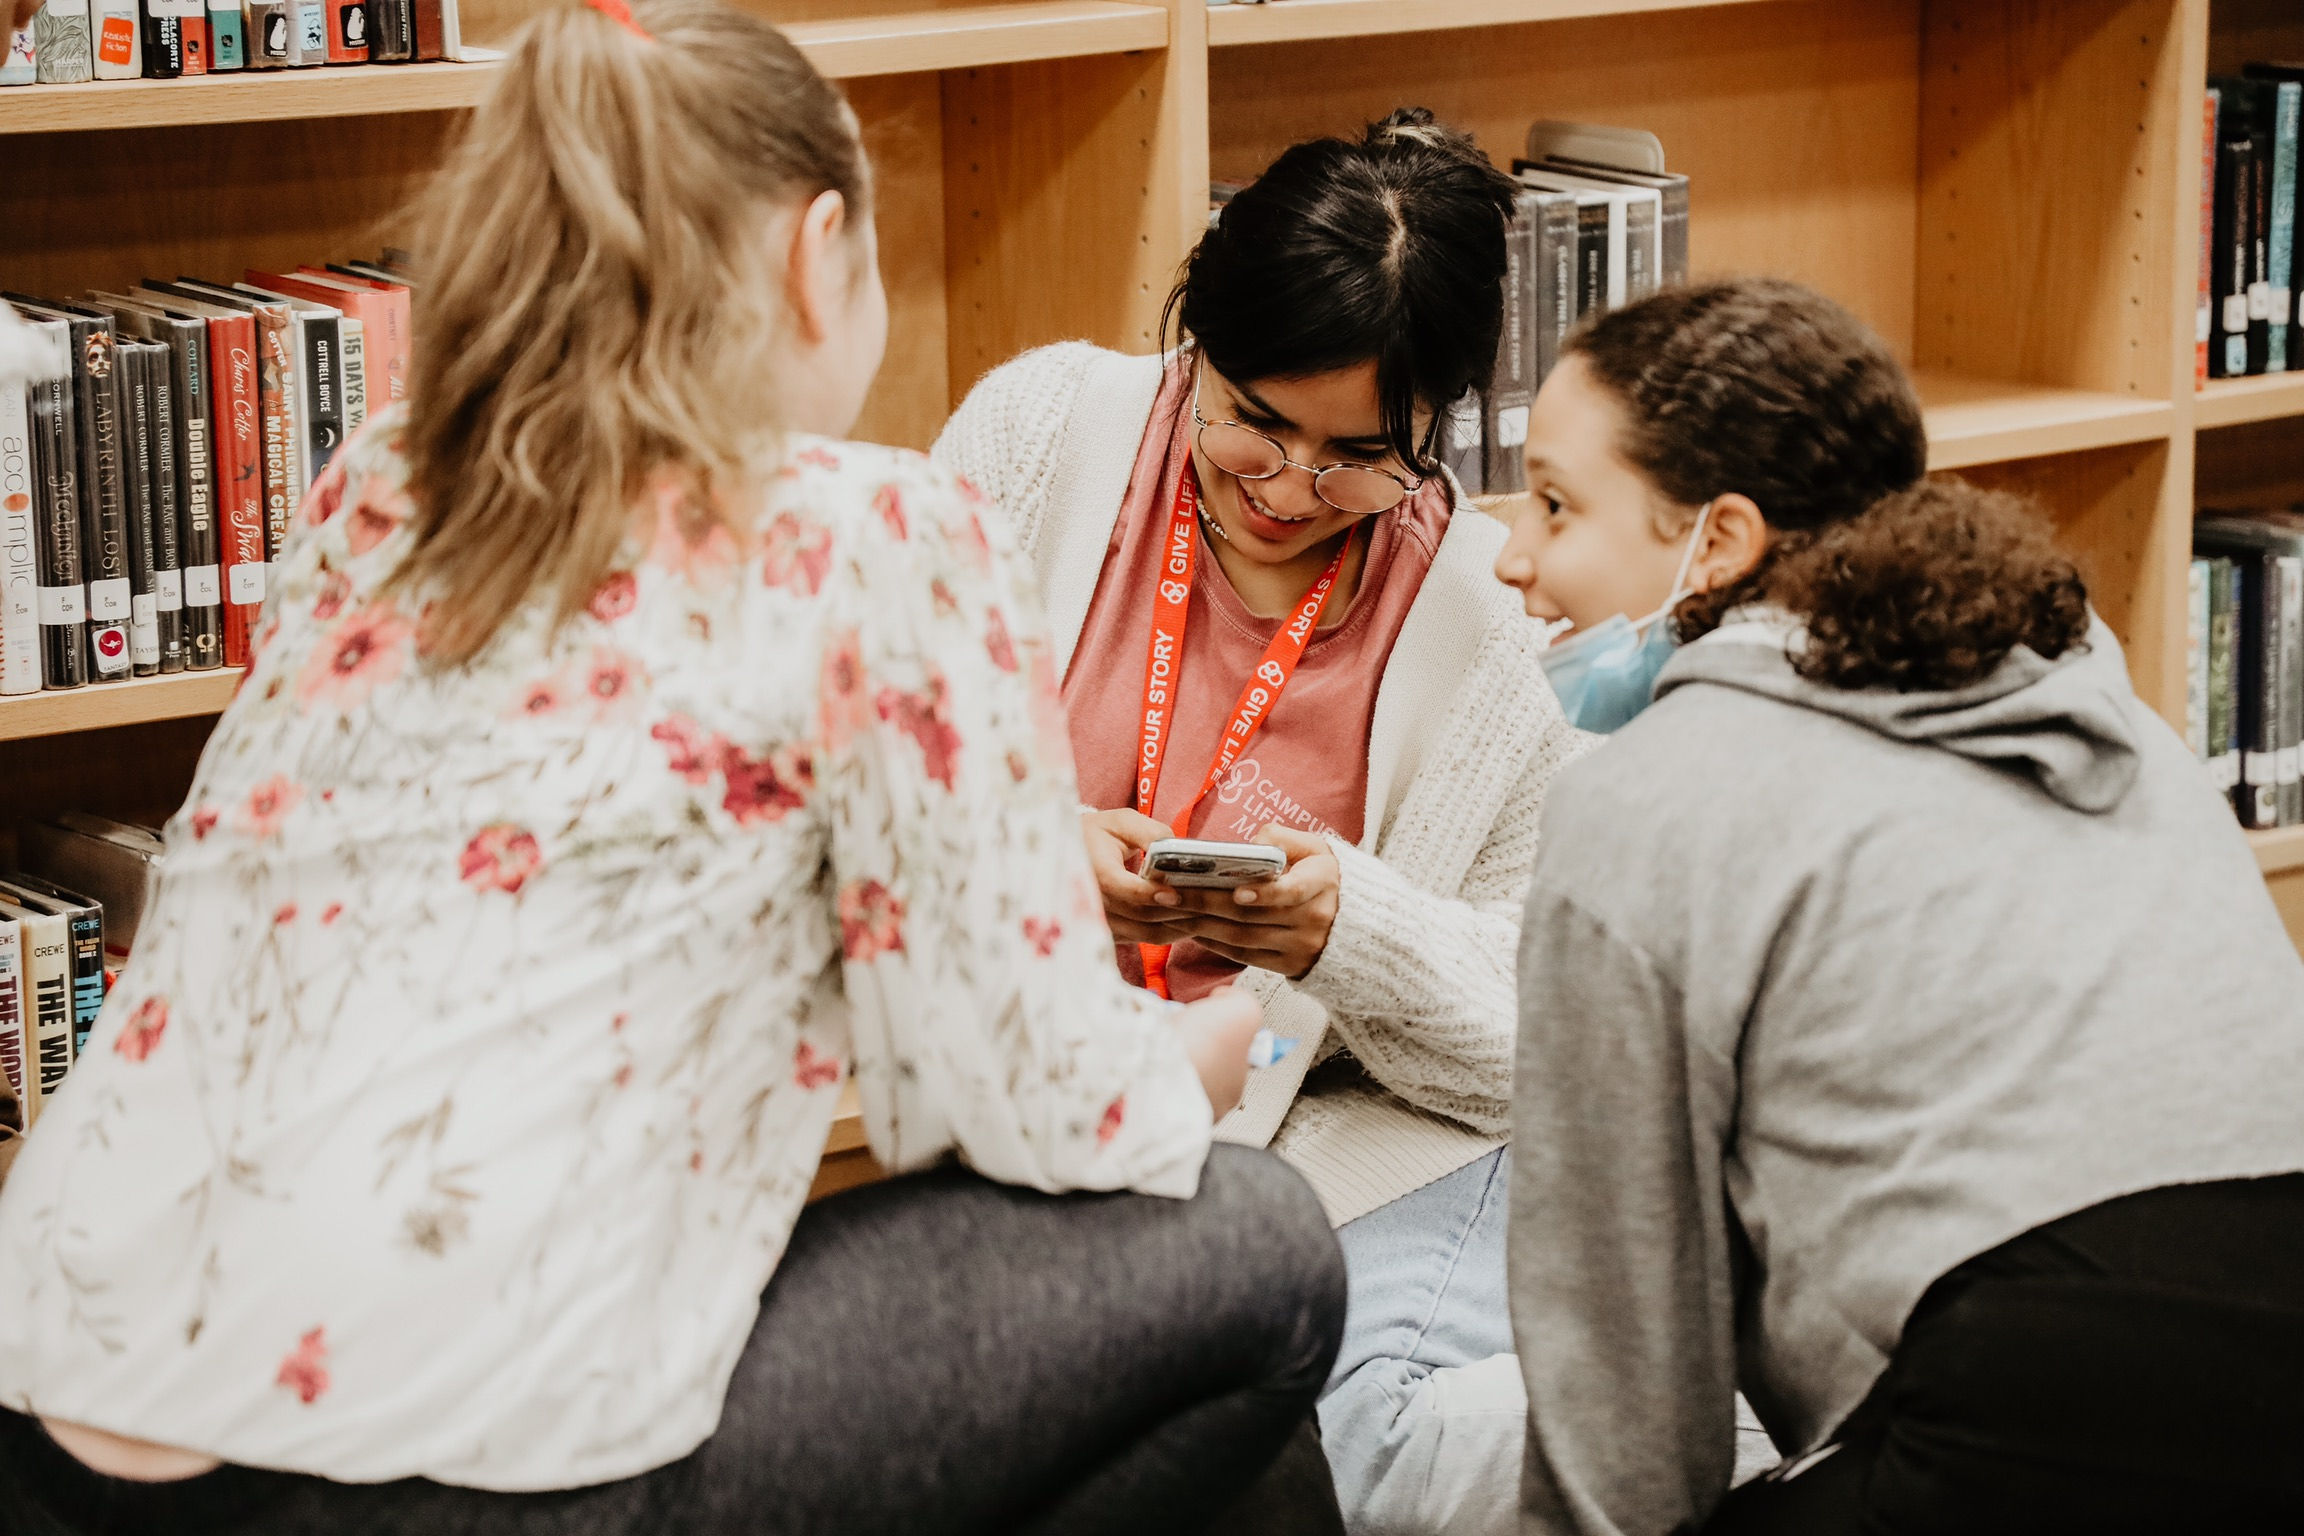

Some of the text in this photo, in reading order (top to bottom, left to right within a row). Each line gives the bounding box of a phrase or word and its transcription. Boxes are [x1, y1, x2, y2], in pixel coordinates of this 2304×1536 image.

[188, 339, 198, 396] COLLARD
[268, 331, 287, 367] COTTER
[343, 336, 361, 355] 15
[135, 384, 145, 422] ROBERT
[230, 348, 253, 441] Charis Cotter
[281, 371, 295, 423] SAINT
[317, 340, 331, 413] COTTRELL BOYCE
[345, 362, 363, 405] DAYS
[52, 377, 61, 436] CORNWELL
[156, 385, 168, 422] ROBERT
[138, 427, 150, 473] CORMIER
[159, 427, 172, 473] CORMIER
[188, 418, 209, 531] Double Eagle
[267, 415, 283, 489] MAGICAL
[95, 392, 120, 578] LABYRINTH LOST
[166, 548, 177, 570] BON
[1168, 521, 1192, 575] GIVE
[1287, 578, 1331, 646] STORY
[1140, 629, 1174, 806] TO YOUR STORY
[1210, 687, 1269, 782] GIVE LIFE
[34, 943, 65, 958] CREWE
[72, 919, 100, 931] CREWE
[37, 974, 66, 1027] THE
[74, 970, 103, 1024] THE
